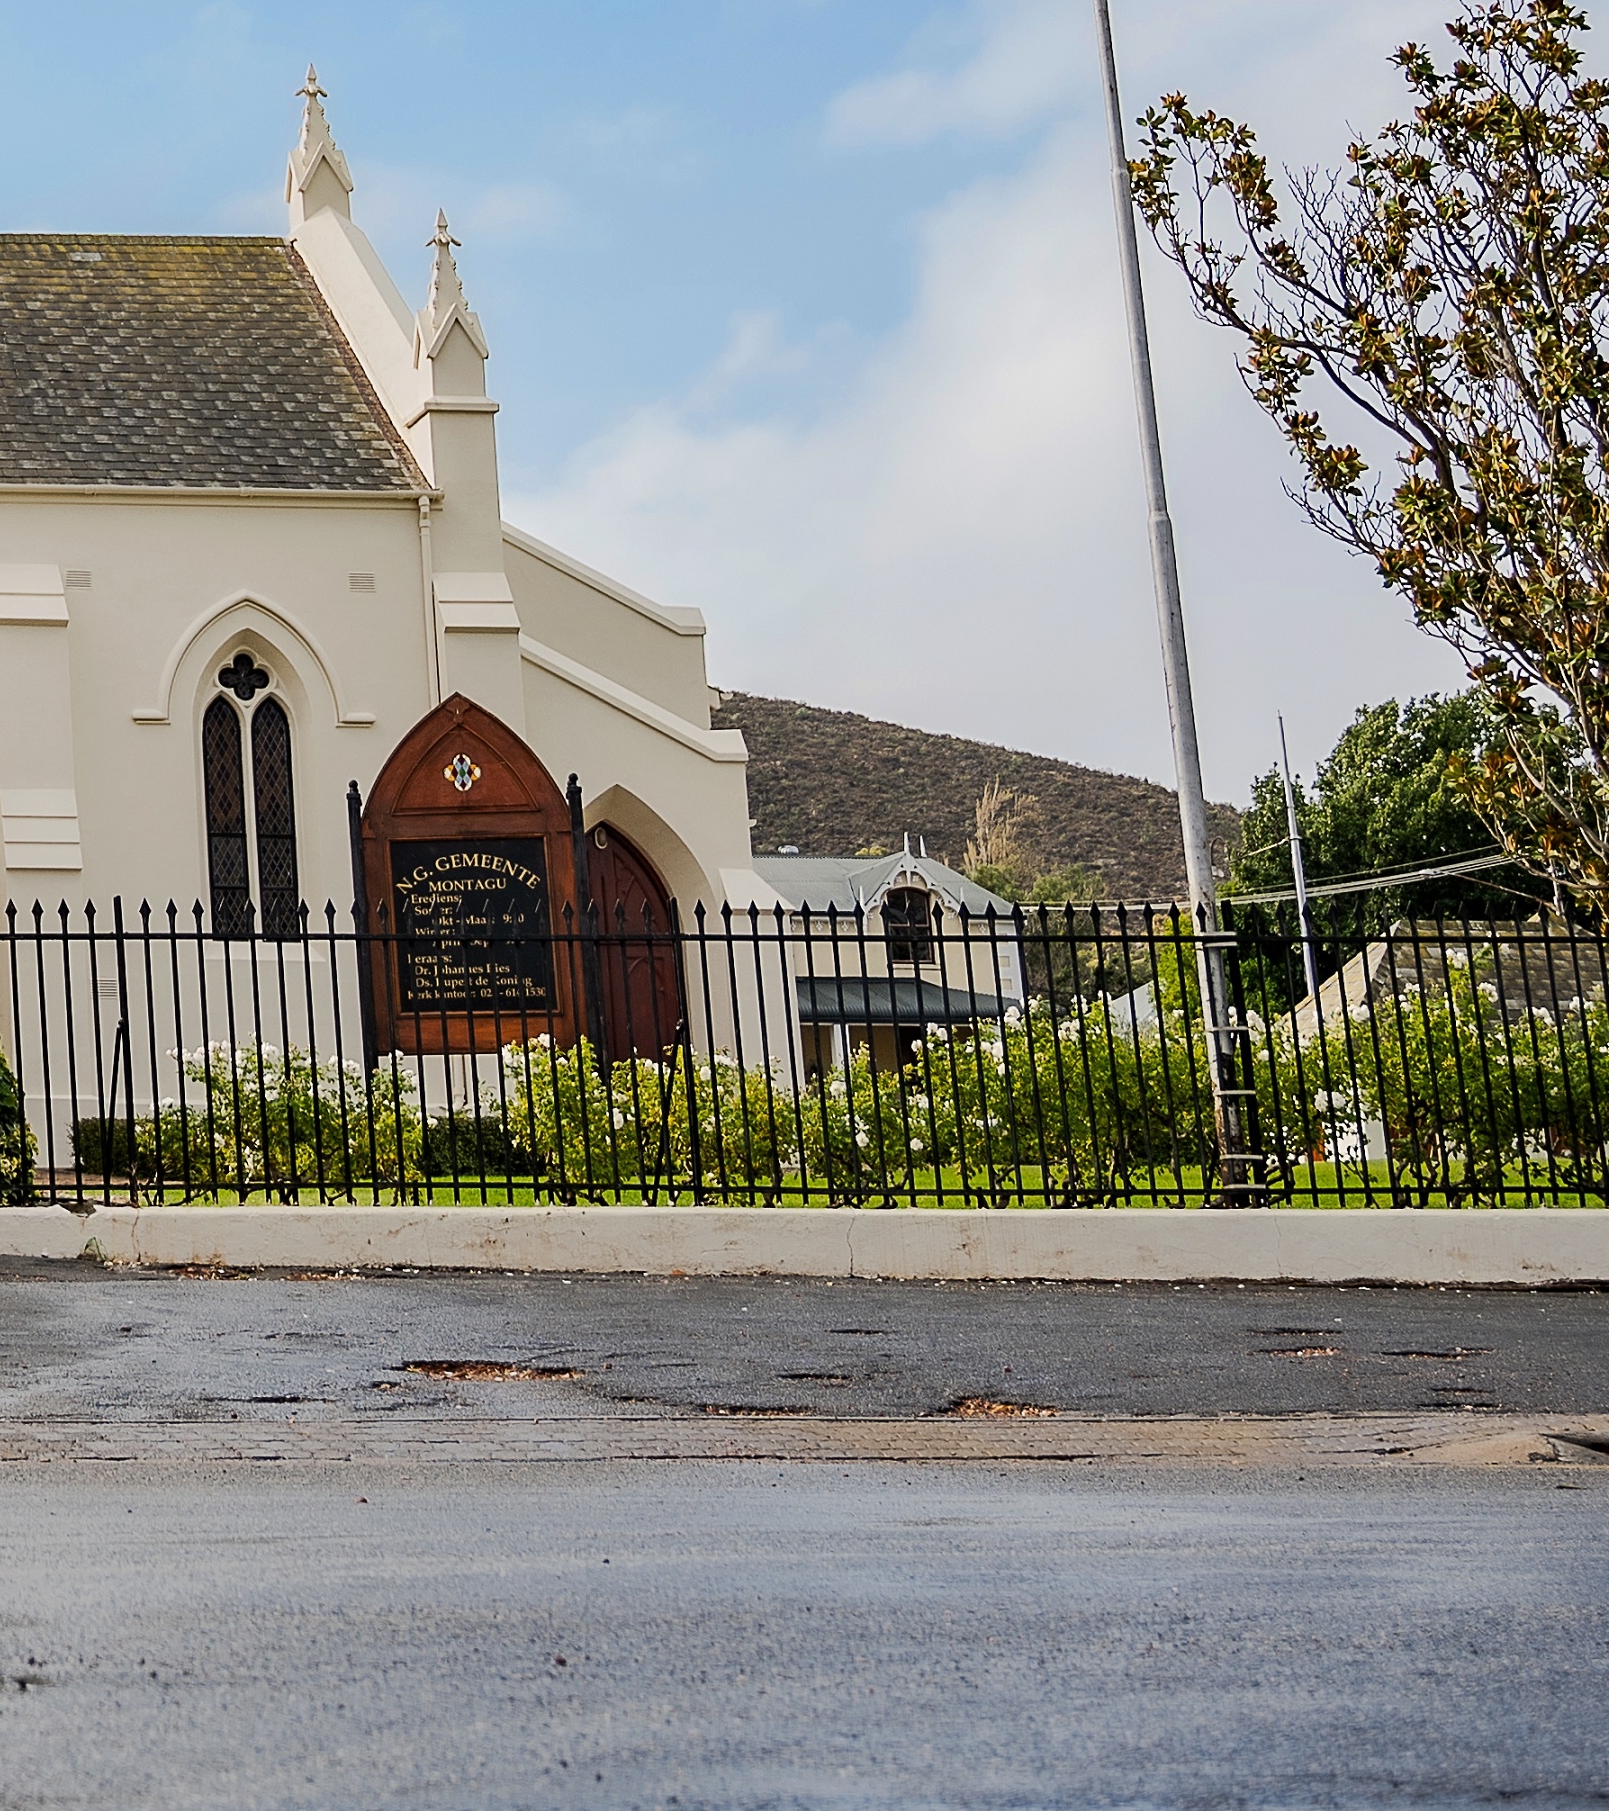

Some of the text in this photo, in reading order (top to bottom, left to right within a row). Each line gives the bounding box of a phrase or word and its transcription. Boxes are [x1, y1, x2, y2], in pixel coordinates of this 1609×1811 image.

[395, 852, 541, 895] N.G. GEMEENTE
[428, 877, 507, 893] MONTAGU
[502, 913, 525, 924] 9:0
[414, 965, 432, 976] Dr.
[433, 964, 484, 978] Jhanes
[415, 977, 434, 988] Ds.
[475, 975, 489, 986] de
